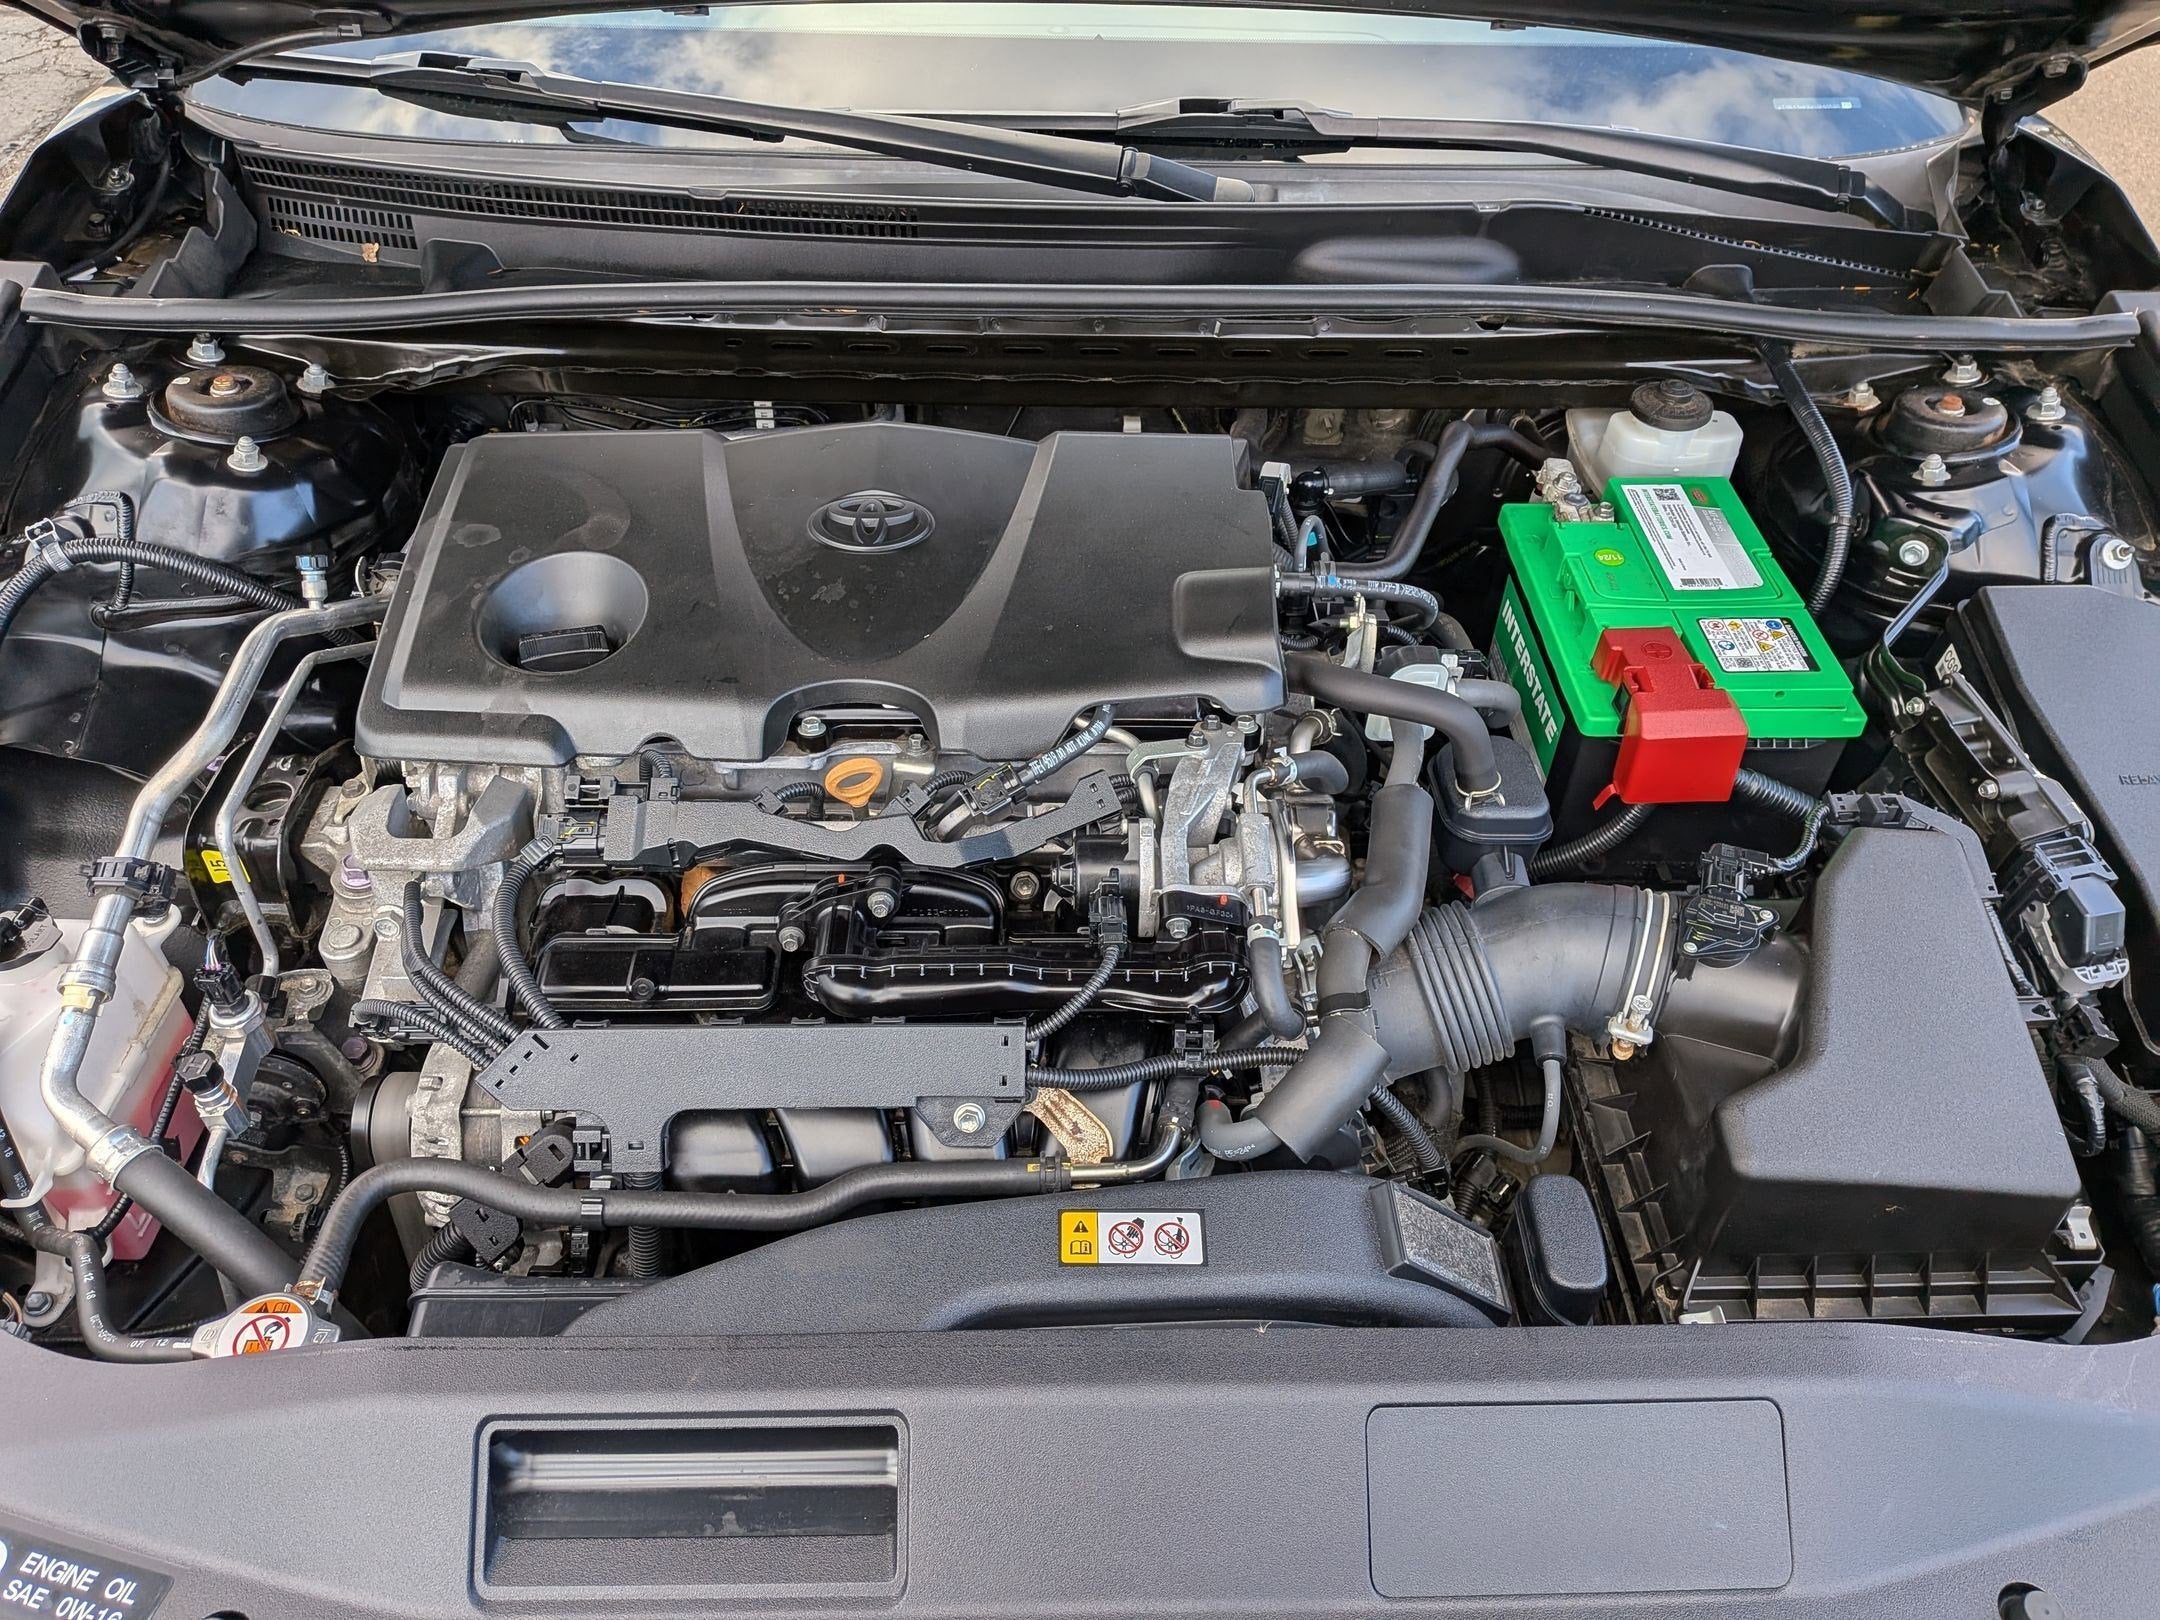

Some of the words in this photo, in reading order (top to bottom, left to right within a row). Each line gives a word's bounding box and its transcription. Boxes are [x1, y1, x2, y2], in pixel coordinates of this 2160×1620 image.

[1501, 597, 1558, 745] INTERSTATE
[3, 1146, 14, 1158] 18
[83, 1272, 95, 1283] 12
[86, 1289, 97, 1301] 18
[19, 1551, 100, 1593] ENGINE
[104, 1577, 138, 1606] OIL
[2, 1578, 50, 1610] SAE
